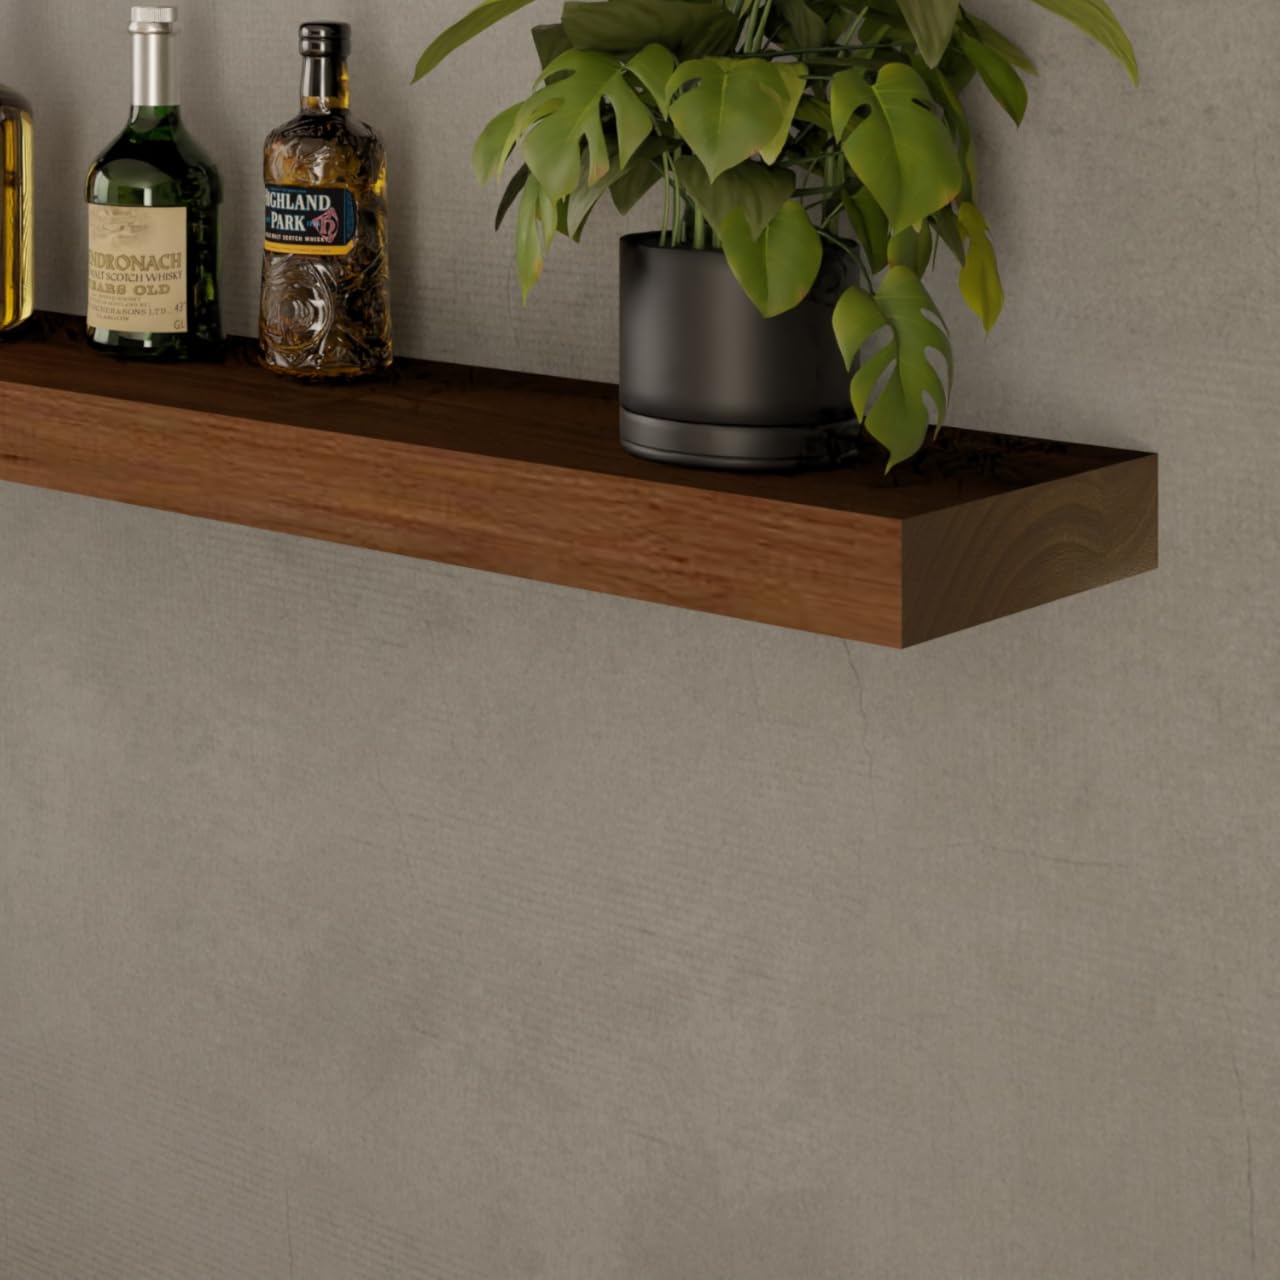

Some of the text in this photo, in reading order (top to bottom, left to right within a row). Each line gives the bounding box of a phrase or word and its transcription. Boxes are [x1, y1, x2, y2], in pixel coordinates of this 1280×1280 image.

[271, 211, 307, 232] PARK
[105, 271, 144, 283] SCOTCH
[144, 270, 184, 283] WHISKY
[133, 283, 171, 296] OLD
